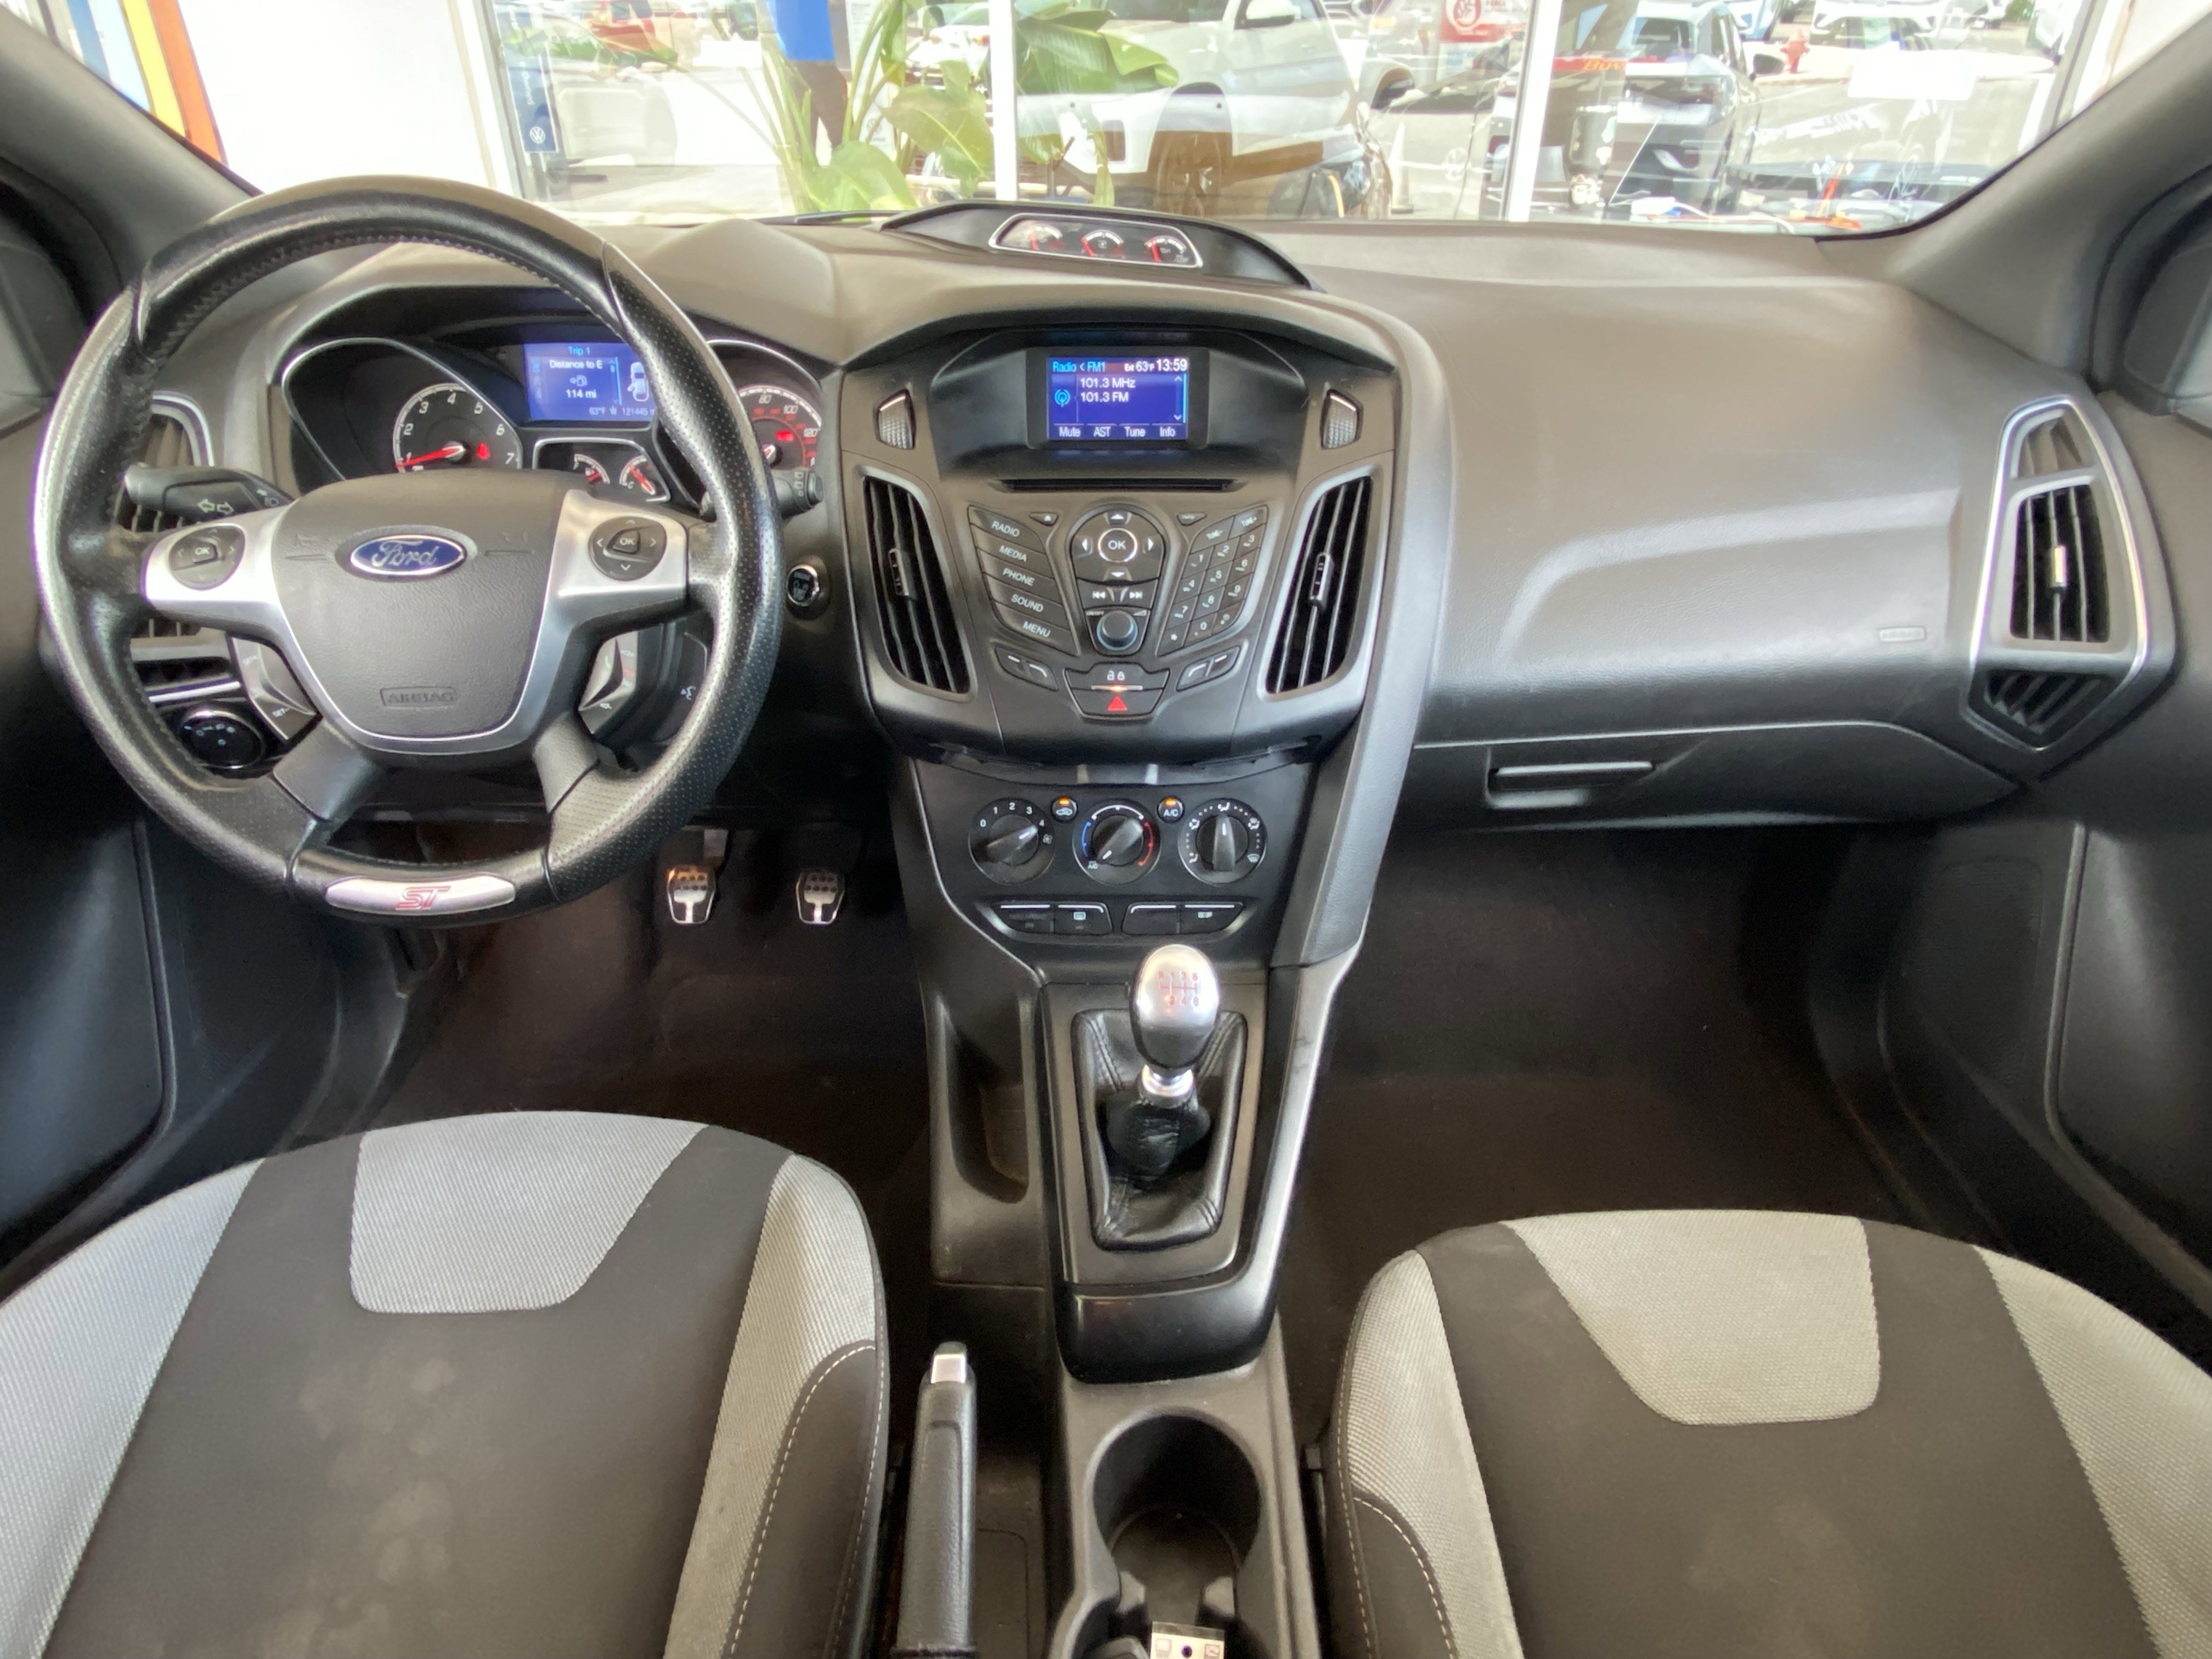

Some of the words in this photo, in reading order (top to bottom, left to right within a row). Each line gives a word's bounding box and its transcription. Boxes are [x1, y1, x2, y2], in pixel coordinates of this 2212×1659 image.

[568, 346, 583, 356] Trip
[549, 360, 584, 369] Distance
[586, 360, 594, 369] to
[596, 360, 602, 369] E
[1052, 362, 1076, 373] Radio
[1087, 362, 1106, 372] FM1
[1157, 359, 1187, 371] 13:59
[1080, 378, 1109, 388] 101.3
[1112, 378, 1136, 388] MHz
[447, 393, 456, 404] 4
[566, 390, 583, 398] 114
[585, 389, 597, 398] mi
[1080, 392, 1109, 402] 101.3
[1113, 392, 1129, 402] FM
[759, 394, 772, 404] 80
[419, 401, 429, 414] 3
[474, 402, 483, 414] 5
[783, 405, 798, 414] 100
[404, 424, 413, 436] 2
[496, 424, 505, 436] 6
[1059, 427, 1081, 437] Mute
[1093, 427, 1111, 437] AST
[1124, 427, 1146, 437] Tune
[1159, 427, 1175, 437] Info
[505, 453, 515, 465] 7
[628, 481, 634, 489] C
[991, 521, 1020, 537] RADIO
[619, 537, 635, 546] OK
[1249, 534, 1255, 543] 3
[1108, 540, 1126, 550] OK
[1223, 545, 1229, 554] 2
[195, 546, 210, 555] OK
[371, 540, 440, 567] Ford
[998, 545, 1027, 562] MEDIA
[1242, 558, 1248, 568] 6
[1002, 568, 1035, 586] PHONE
[1215, 571, 1222, 579] 5
[1188, 580, 1195, 588] 4
[1234, 585, 1241, 593] 9
[1011, 594, 1044, 613] SOUND
[1208, 595, 1214, 604] 8
[1023, 621, 1051, 637] MENU
[1200, 622, 1207, 630] 0
[1009, 802, 1015, 810] 2
[1026, 806, 1032, 815] 3
[980, 819, 986, 827] 0
[395, 885, 452, 910] ST
[1169, 997, 1175, 1005] 2
